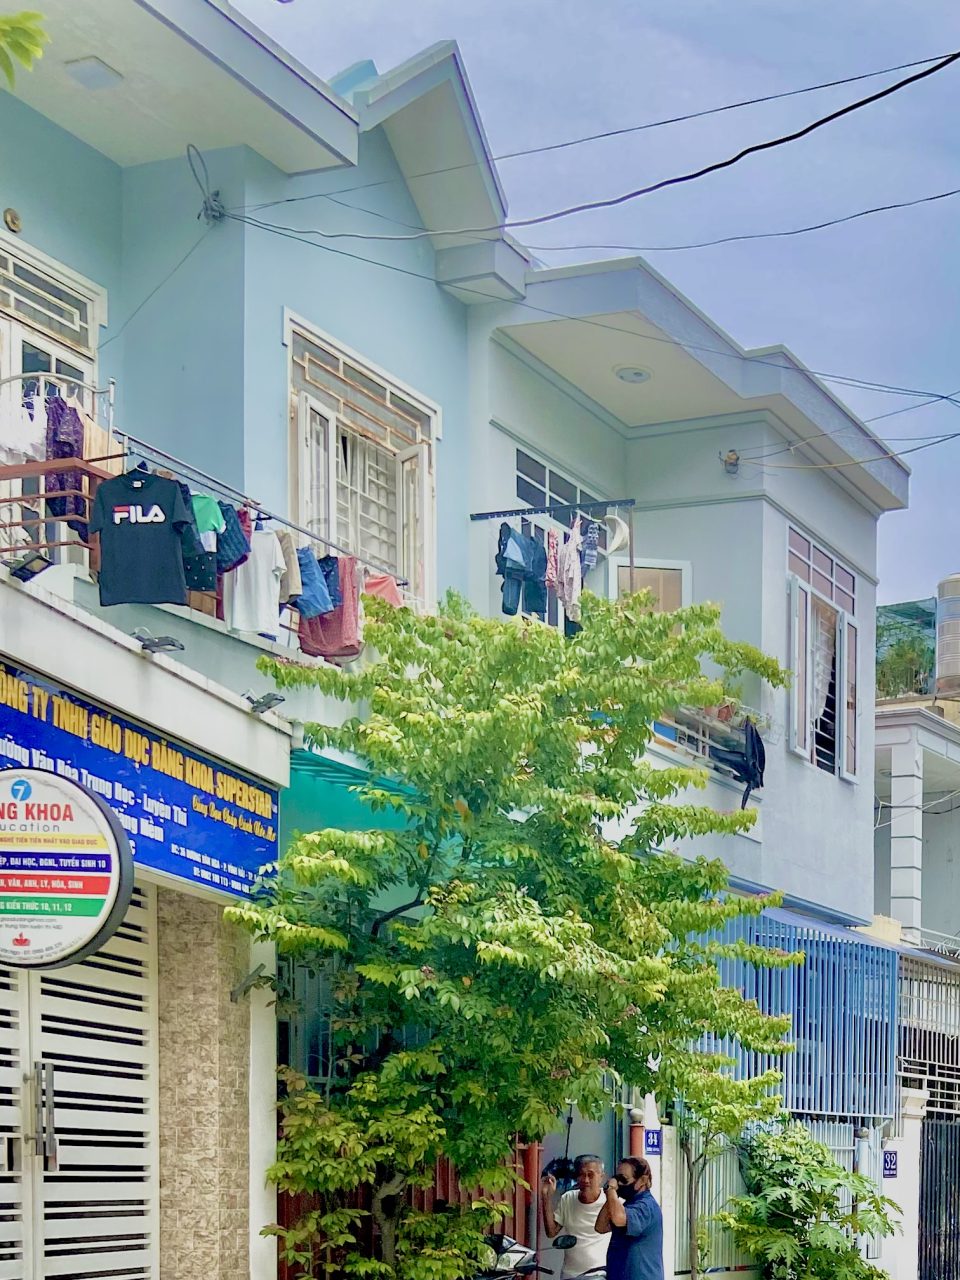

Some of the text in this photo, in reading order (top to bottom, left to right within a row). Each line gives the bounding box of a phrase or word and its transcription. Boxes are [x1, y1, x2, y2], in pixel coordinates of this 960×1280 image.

[113, 505, 166, 524] FILA
[32, 685, 48, 722] TY
[52, 695, 88, 739] TNHH
[91, 713, 121, 754] GIÁO
[124, 728, 149, 769] DỤC
[152, 740, 184, 781] ĐĂNG
[25, 802, 74, 821] KHOA
[81, 859, 96, 868] SINH
[98, 859, 106, 868] 10
